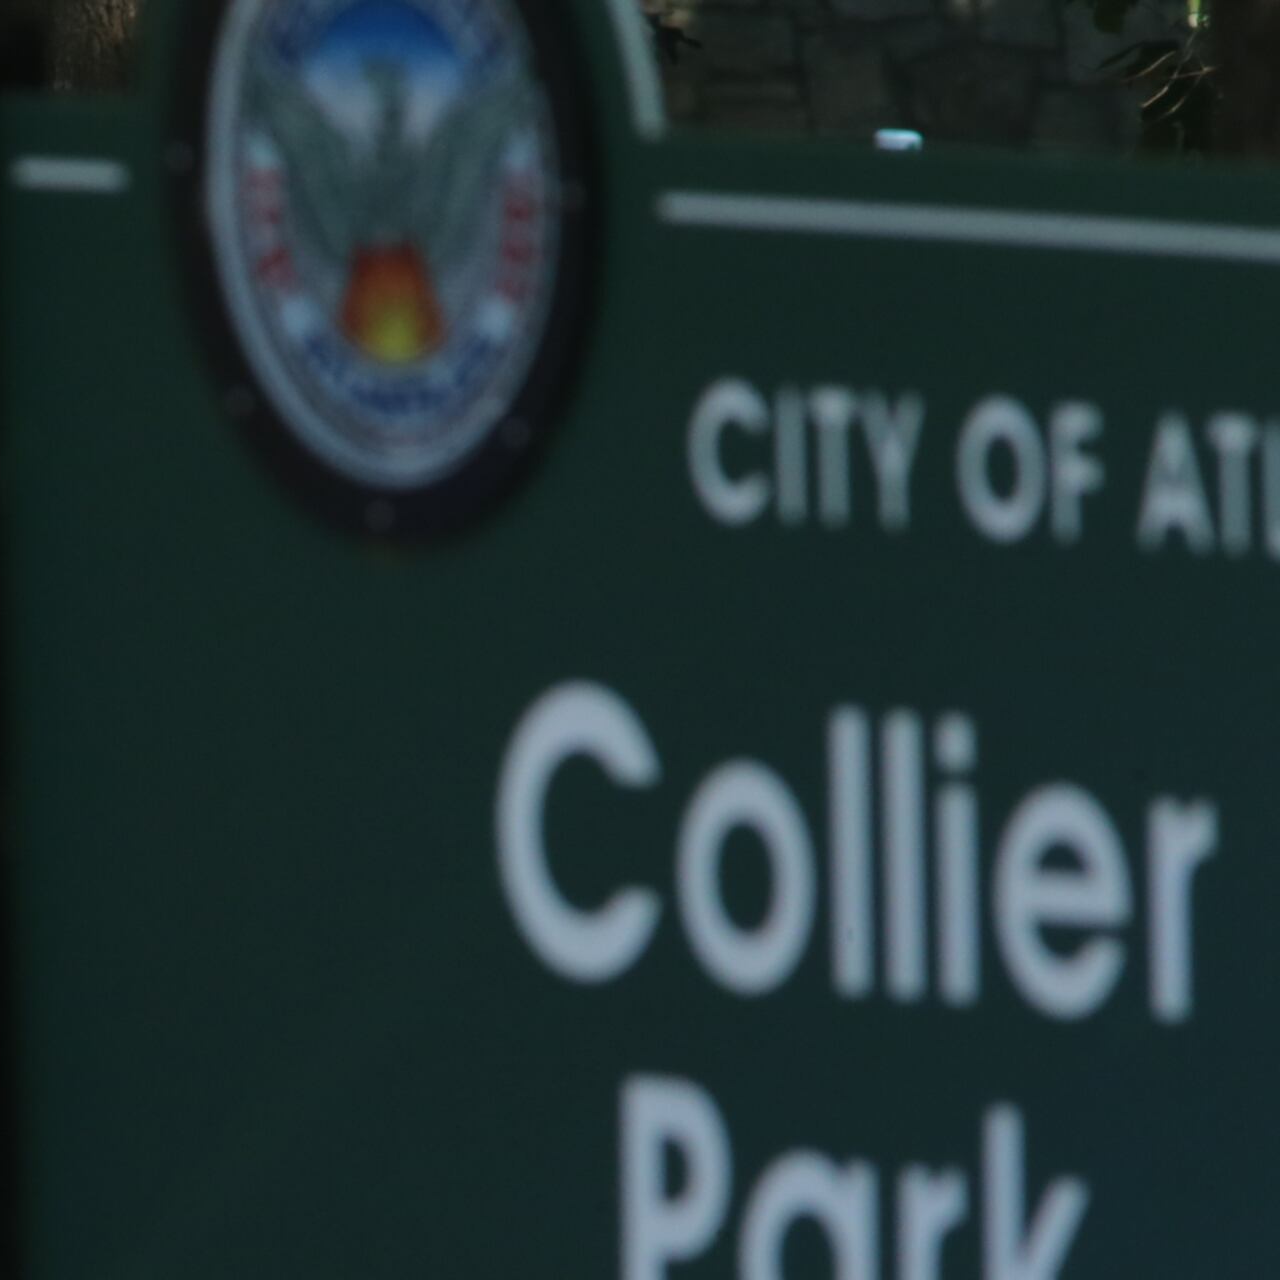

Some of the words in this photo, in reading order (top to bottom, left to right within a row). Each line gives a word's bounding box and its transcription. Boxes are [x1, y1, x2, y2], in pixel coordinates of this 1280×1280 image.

[688, 376, 926, 532] CITY
[956, 393, 1104, 544] OF
[494, 678, 1220, 1026] Collier
